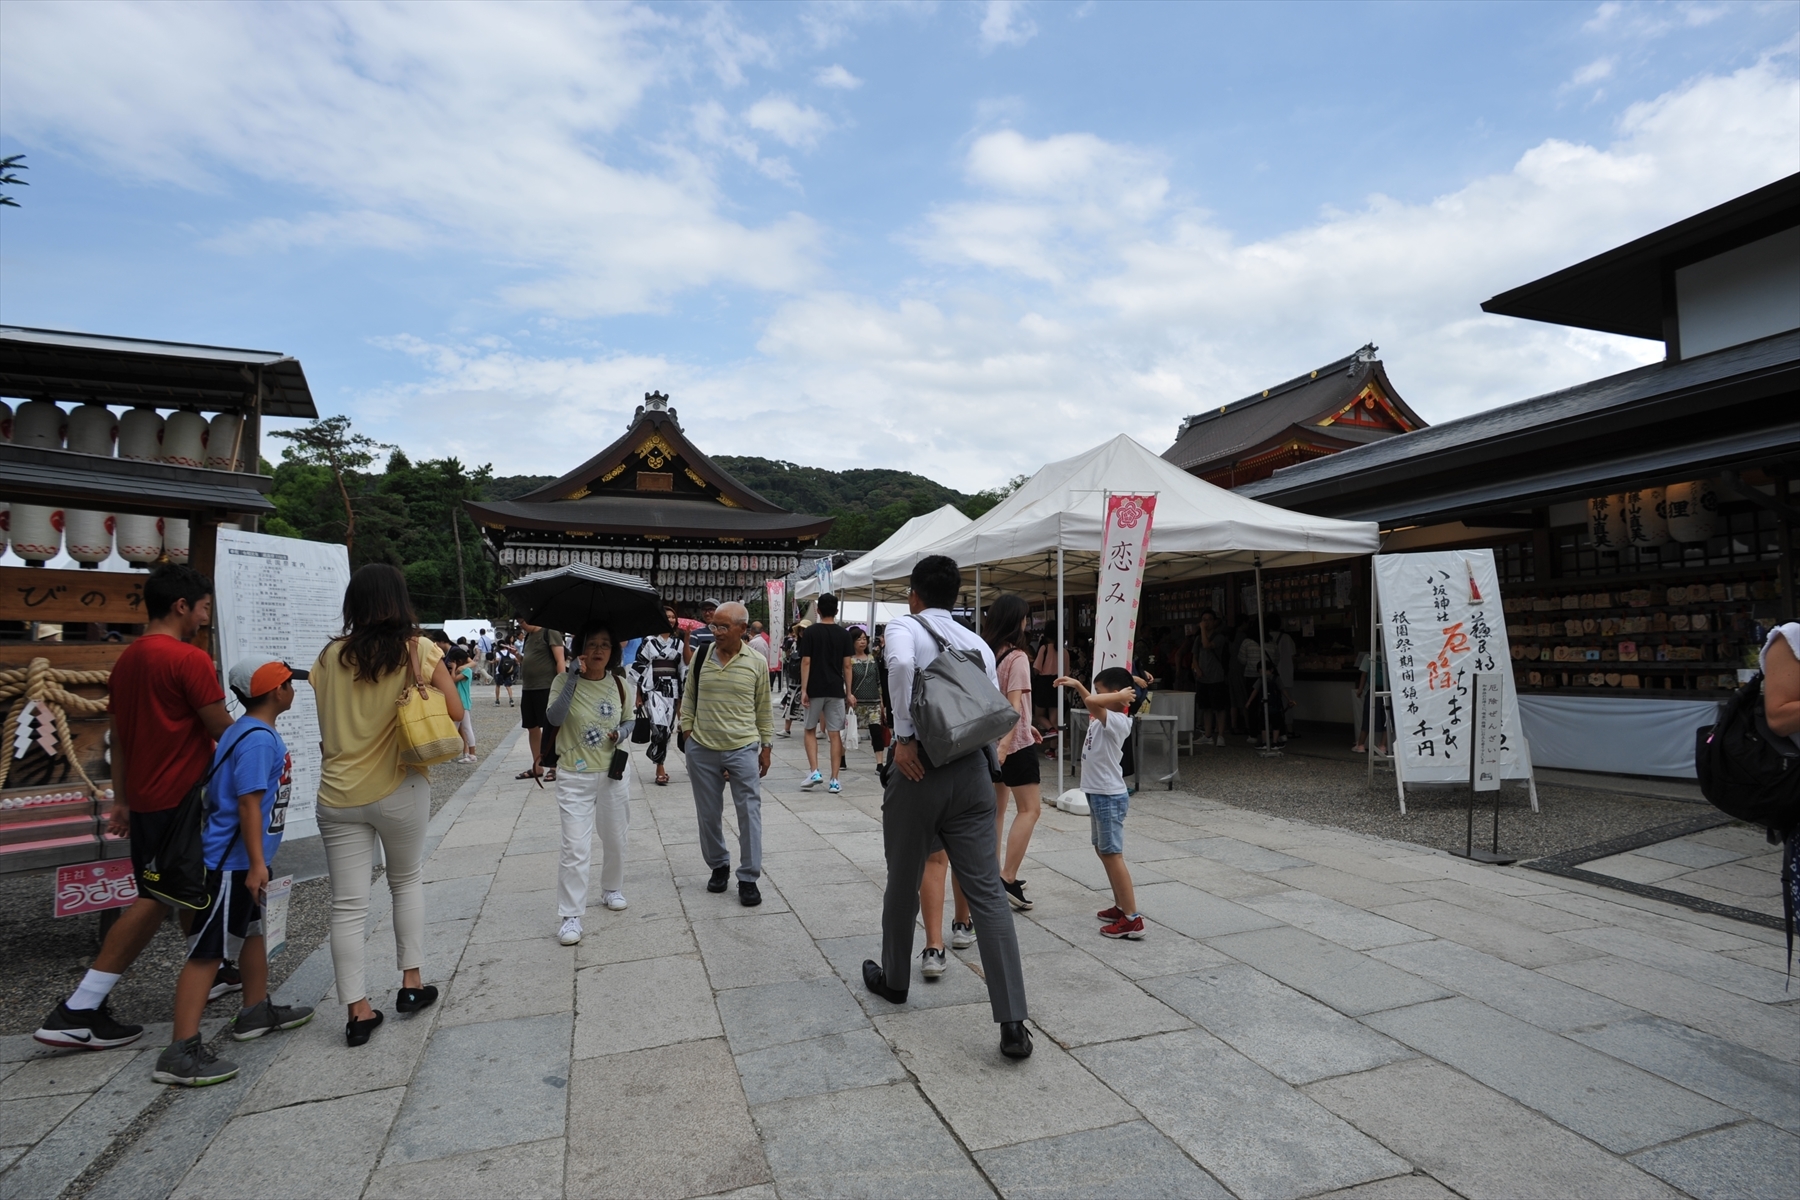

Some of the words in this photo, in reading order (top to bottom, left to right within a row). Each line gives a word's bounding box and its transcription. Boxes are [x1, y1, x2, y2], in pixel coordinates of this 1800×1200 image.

[1427, 570, 1451, 622] 八坂神社
[1488, 684, 1498, 753] 厄除ぜんざい
